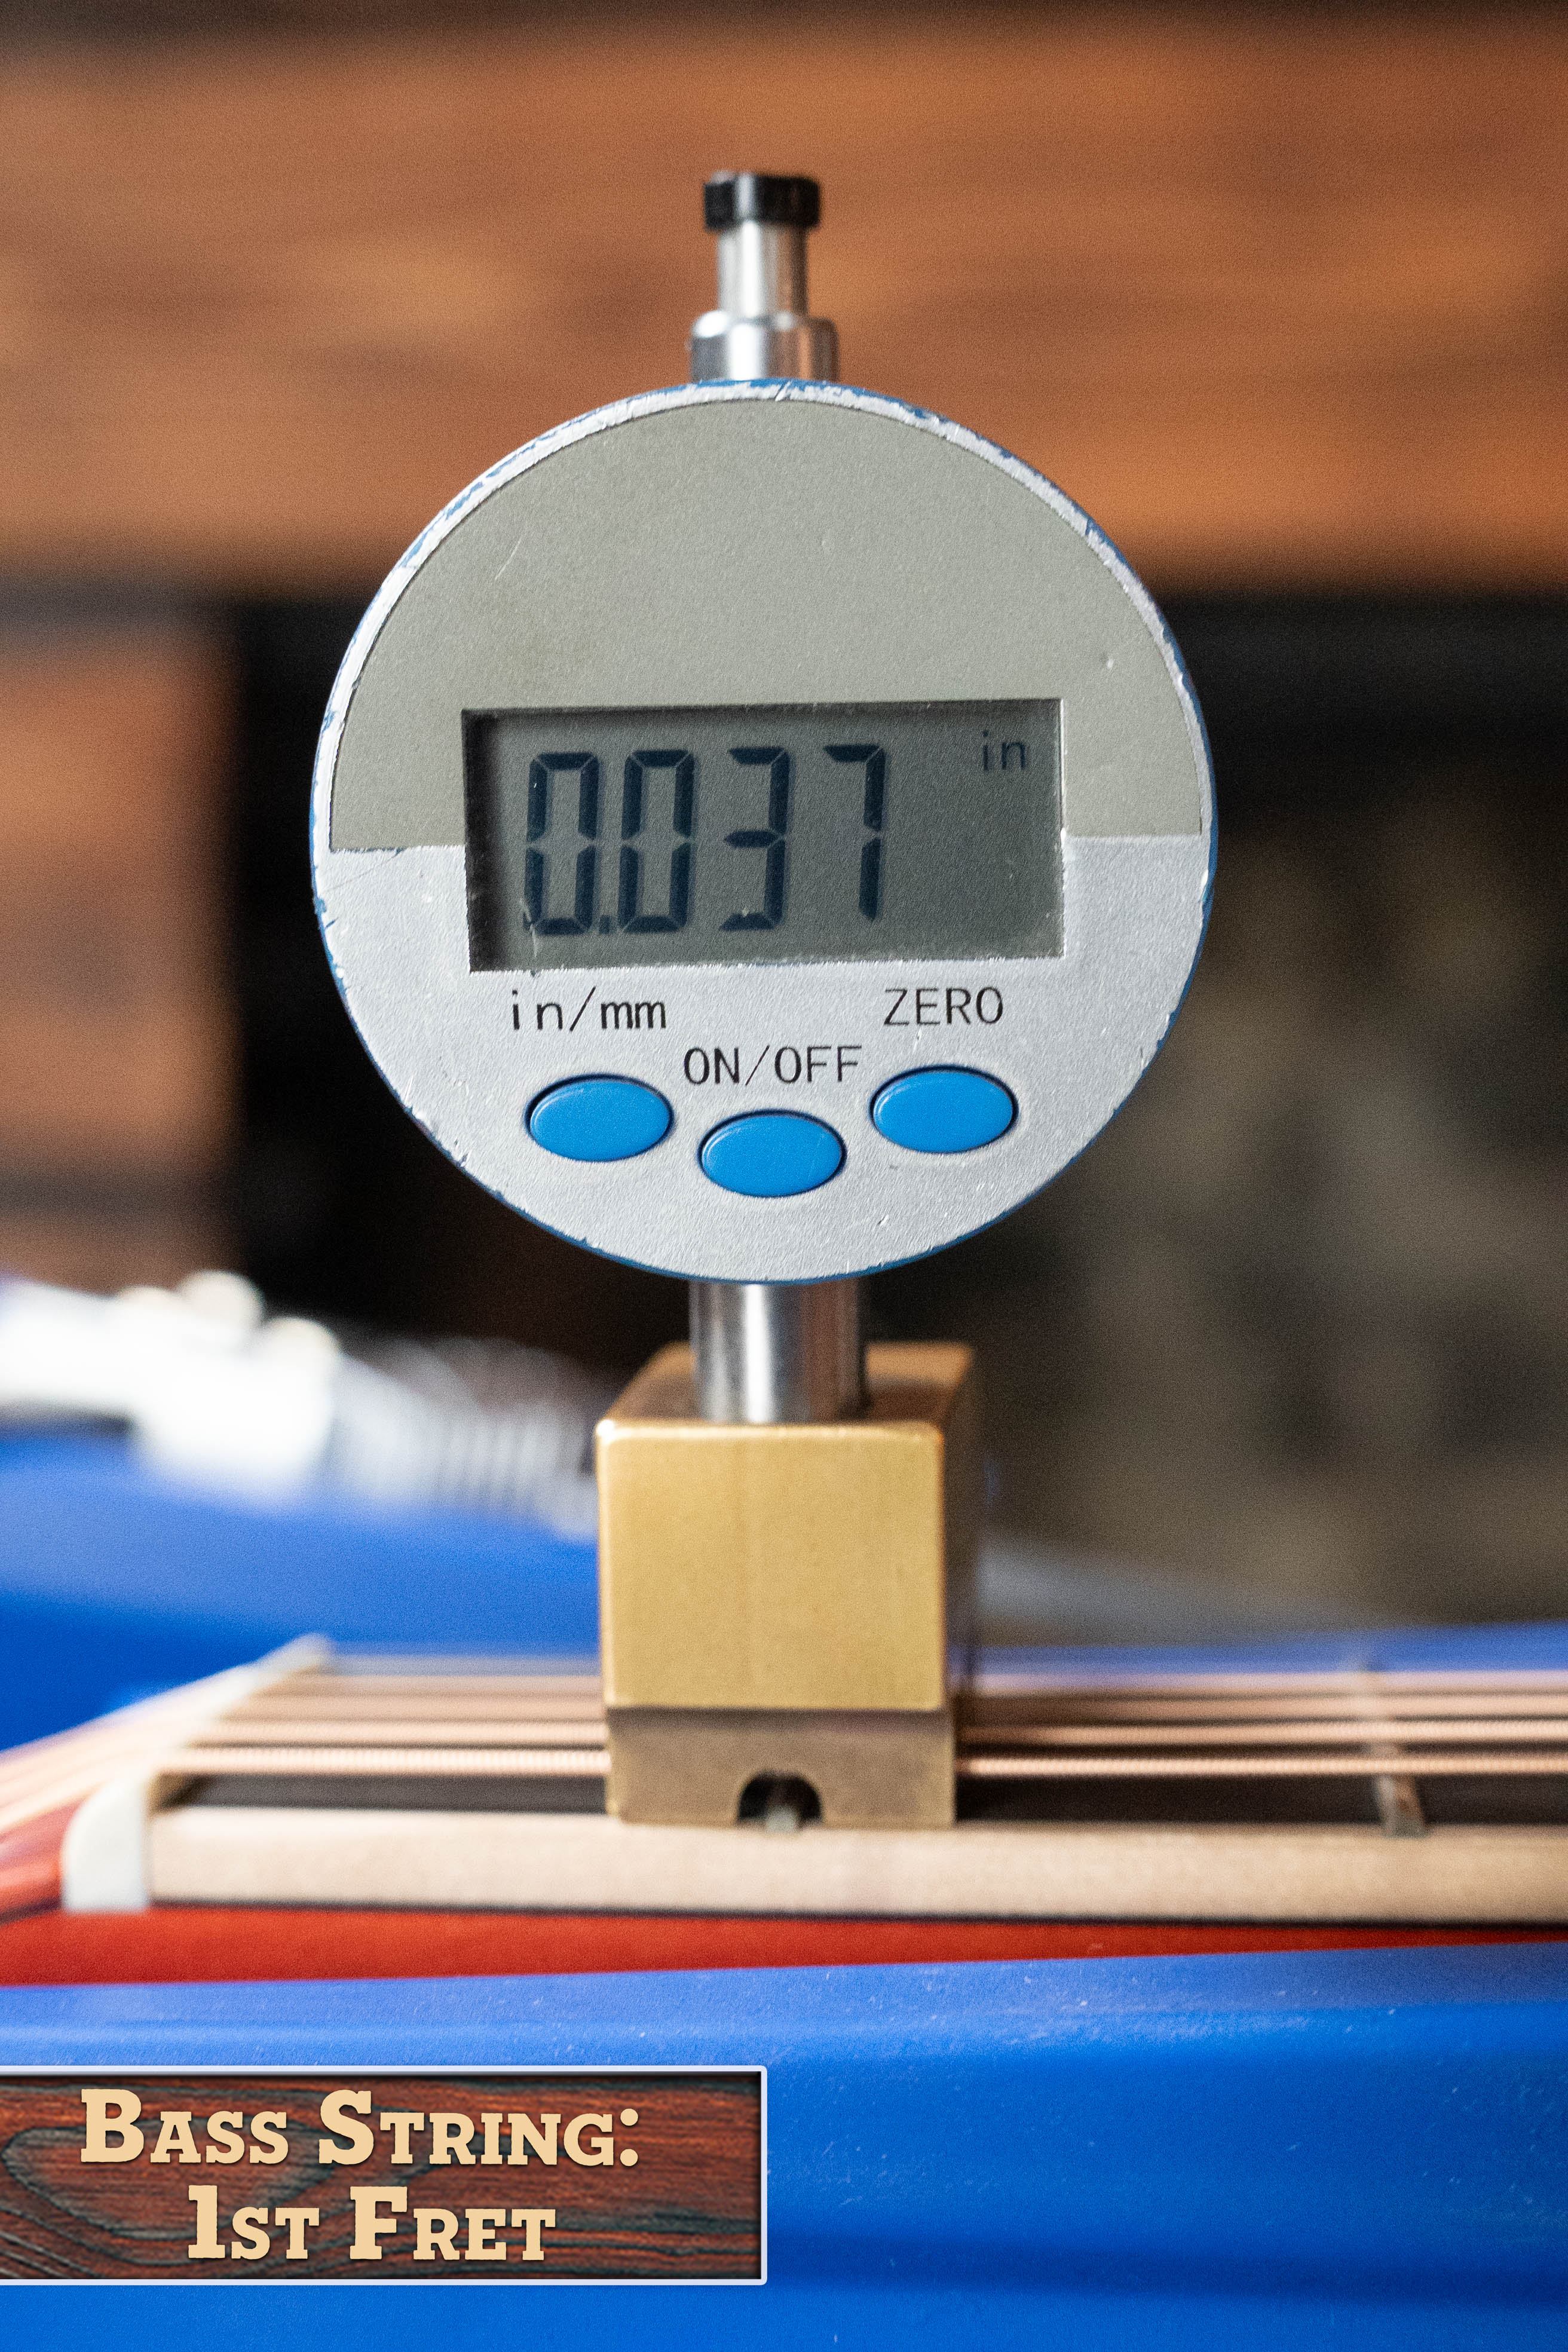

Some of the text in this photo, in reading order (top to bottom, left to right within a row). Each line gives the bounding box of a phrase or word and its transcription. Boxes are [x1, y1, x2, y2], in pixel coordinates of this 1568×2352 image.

[980, 730, 1028, 772] in
[523, 745, 886, 936] 0.037
[512, 986, 666, 1032] in/mm
[883, 986, 1004, 1026] ZERO
[684, 1045, 862, 1086] ON/OFF
